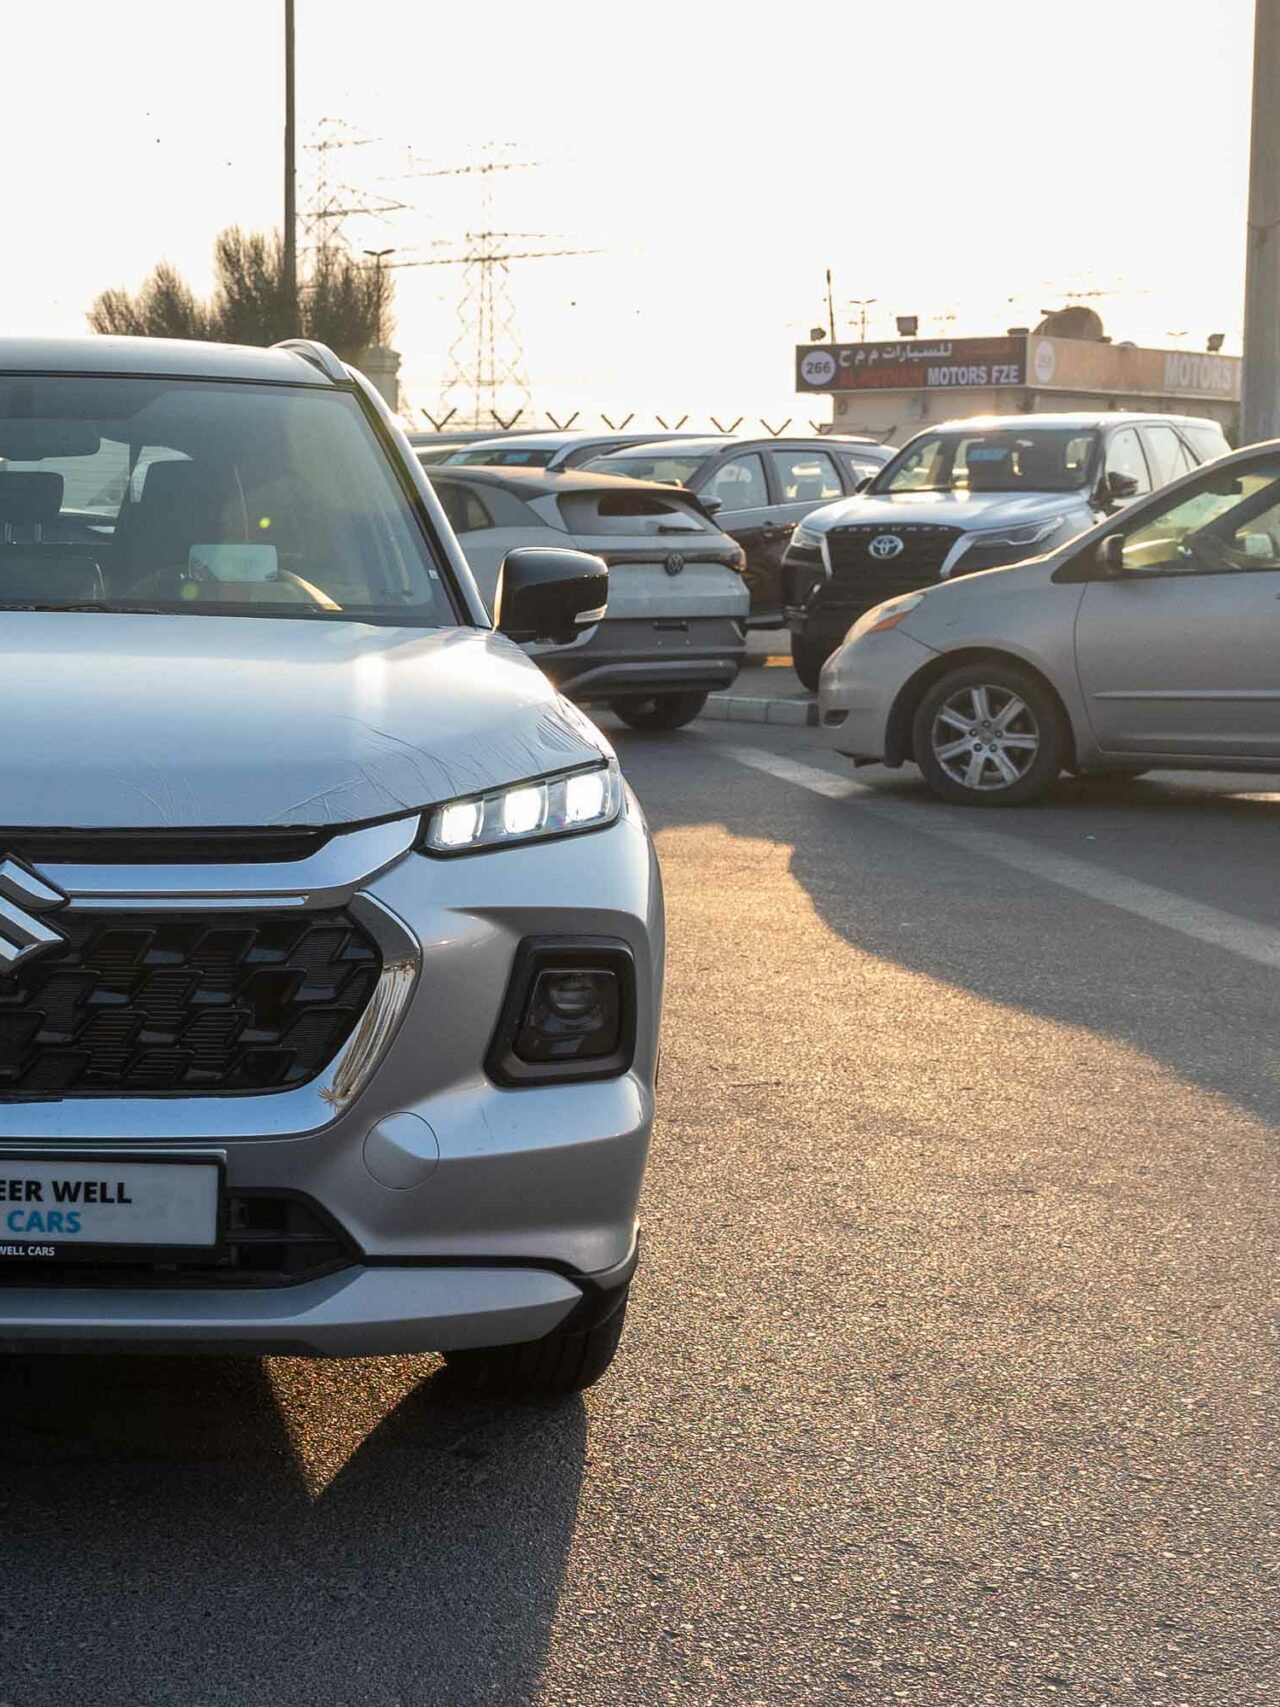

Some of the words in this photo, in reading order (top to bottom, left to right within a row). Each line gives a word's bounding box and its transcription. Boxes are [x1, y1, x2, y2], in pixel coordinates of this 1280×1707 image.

[882, 343, 952, 362] للسيارات
[806, 361, 831, 374] 266
[927, 366, 987, 385] MOTORS
[991, 365, 1019, 383] FZE
[1164, 353, 1233, 391] MOTORS
[52, 1181, 132, 1204] WELL
[7, 1210, 81, 1234] CARS
[28, 1246, 55, 1256] CARS
